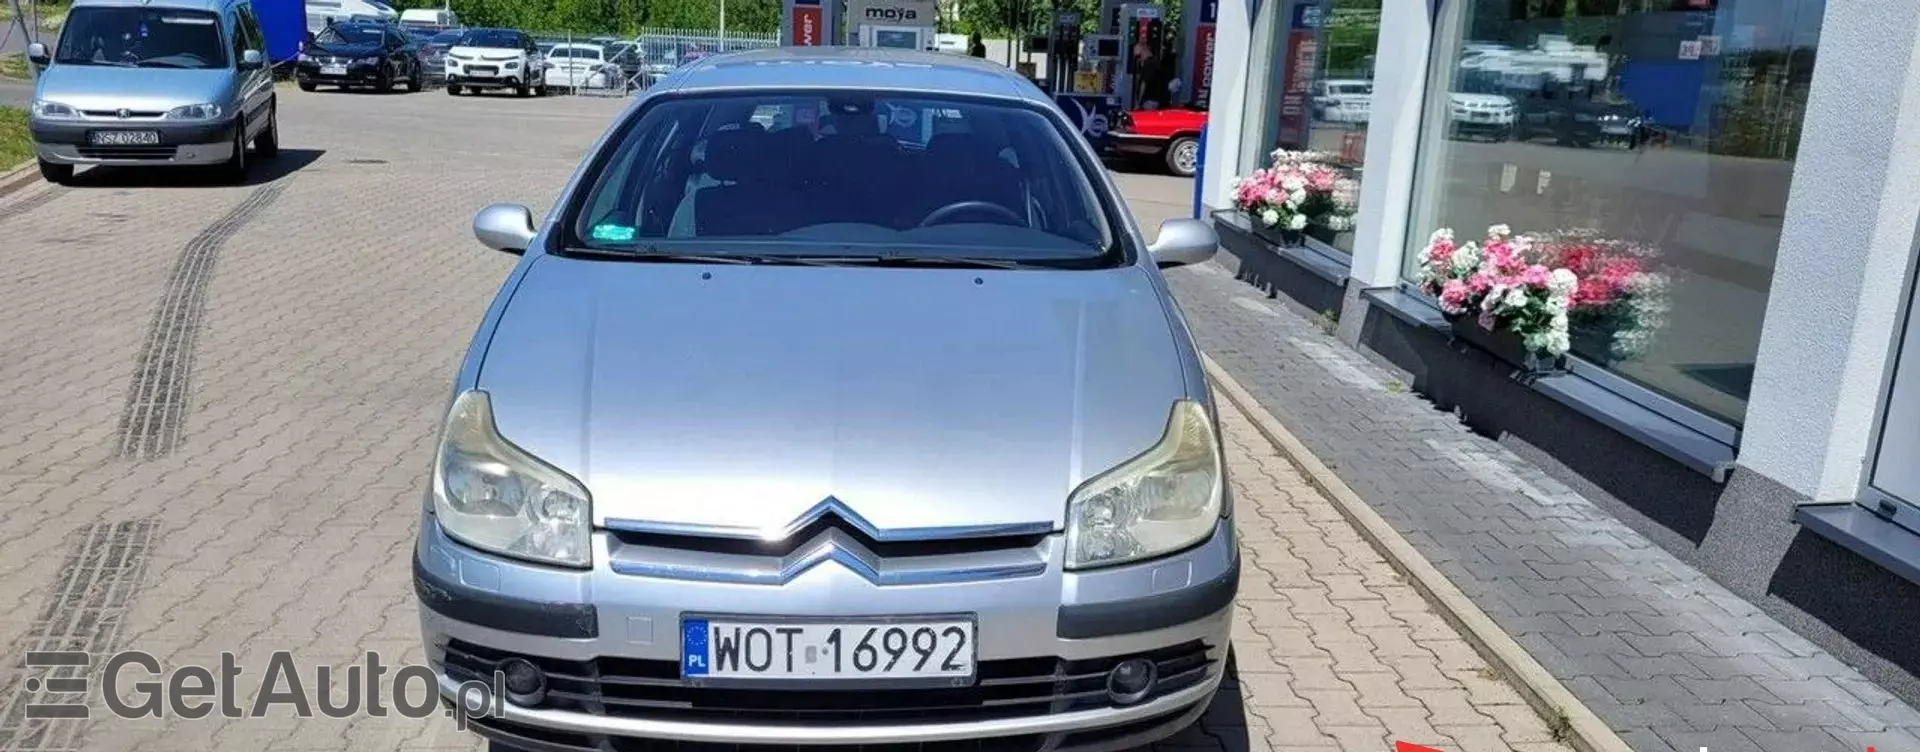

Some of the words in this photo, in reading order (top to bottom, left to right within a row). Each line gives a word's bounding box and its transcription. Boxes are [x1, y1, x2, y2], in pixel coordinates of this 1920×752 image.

[866, 8, 917, 24] moya
[803, 14, 813, 47] wer
[688, 655, 706, 667] PL
[713, 626, 804, 673] WOT
[826, 626, 969, 673] 16992
